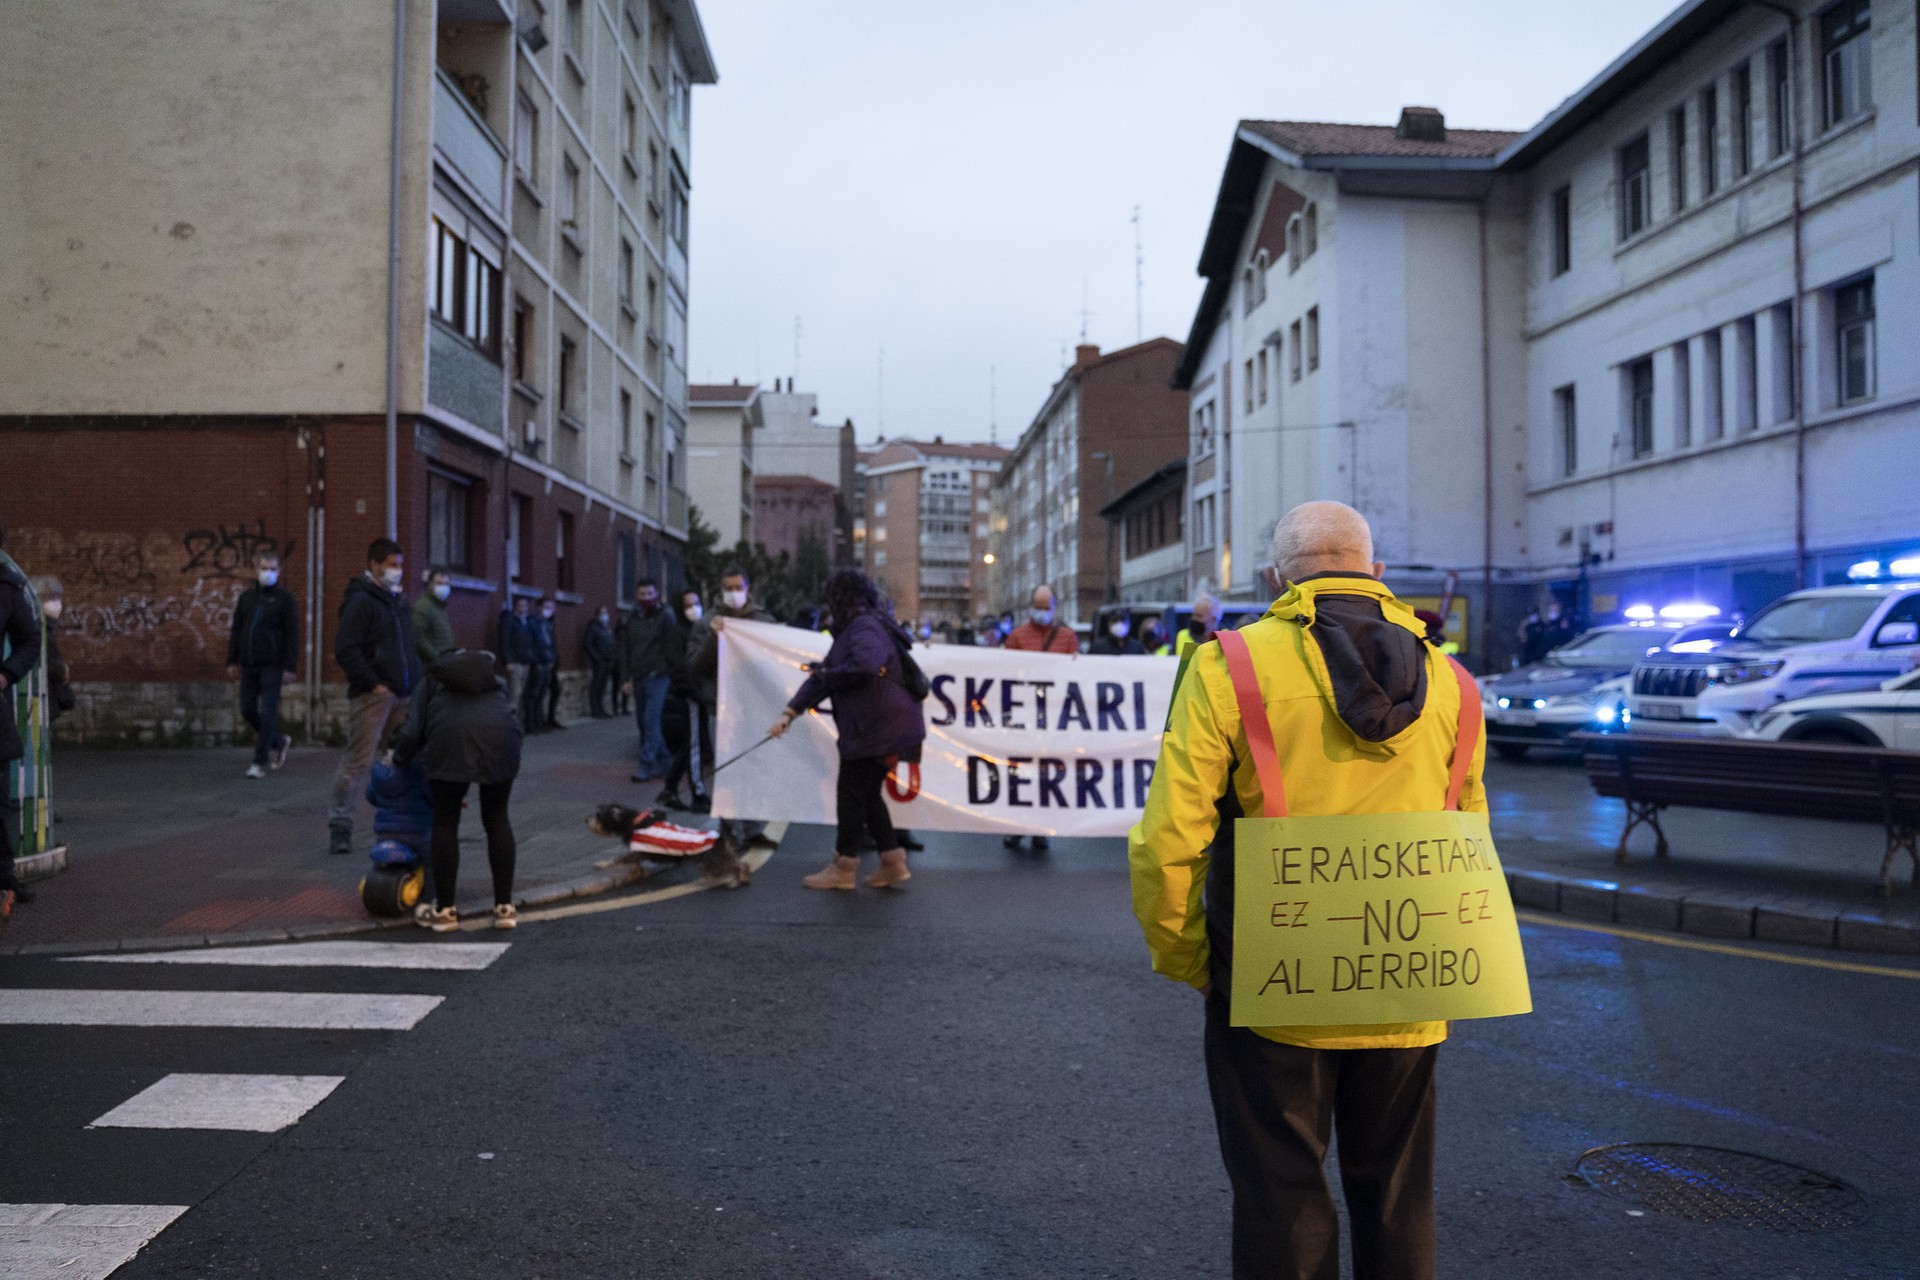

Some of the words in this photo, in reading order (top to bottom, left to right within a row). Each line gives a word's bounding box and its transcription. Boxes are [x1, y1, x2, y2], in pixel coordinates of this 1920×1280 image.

[931, 673, 1147, 731] SKETARI
[966, 755, 1158, 809] DERRIB
[1270, 901, 1309, 928] EZ
[1458, 889, 1493, 924] EZ
[1258, 958, 1315, 996] AL
[1331, 944, 1481, 992] DERRIBO
